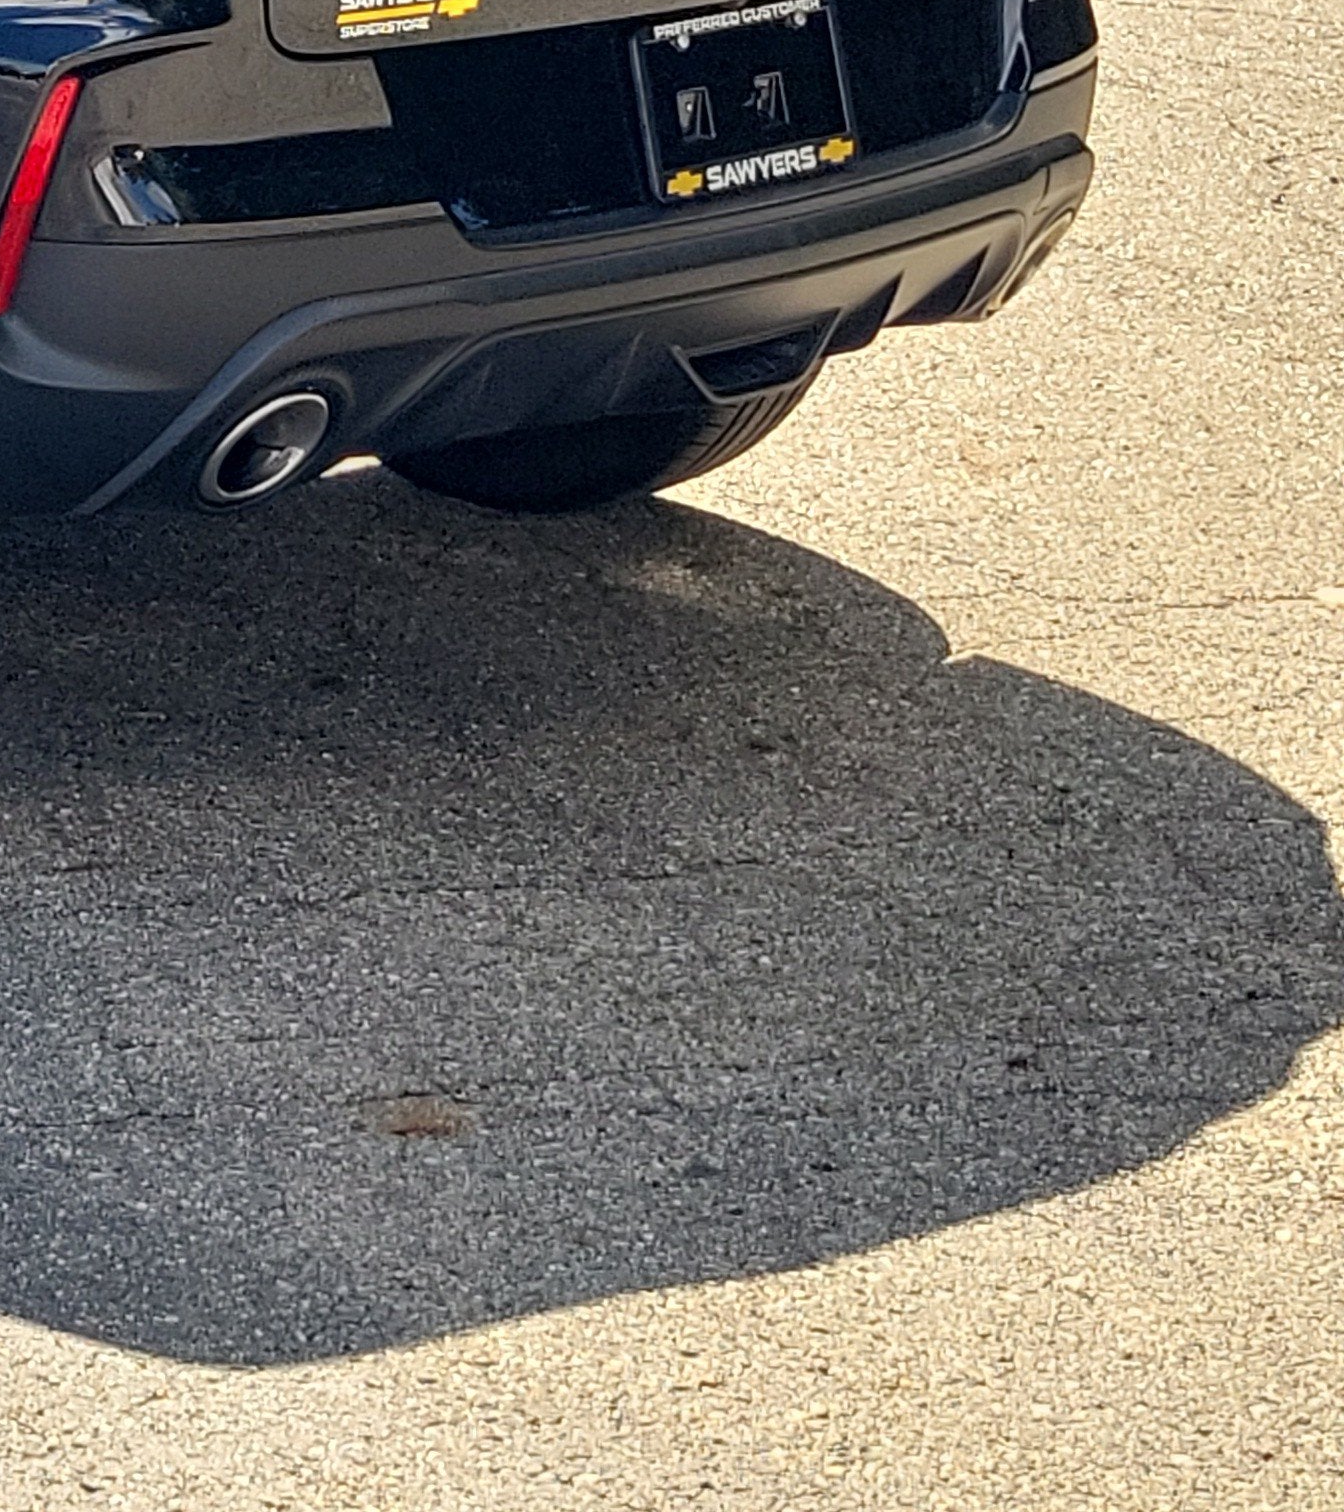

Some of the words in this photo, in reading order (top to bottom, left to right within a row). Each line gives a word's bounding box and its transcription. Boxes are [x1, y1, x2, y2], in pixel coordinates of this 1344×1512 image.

[339, 17, 431, 40] SUPERSTORE
[653, 11, 740, 40] PREFERRED
[705, 145, 818, 192] SAWYERS
